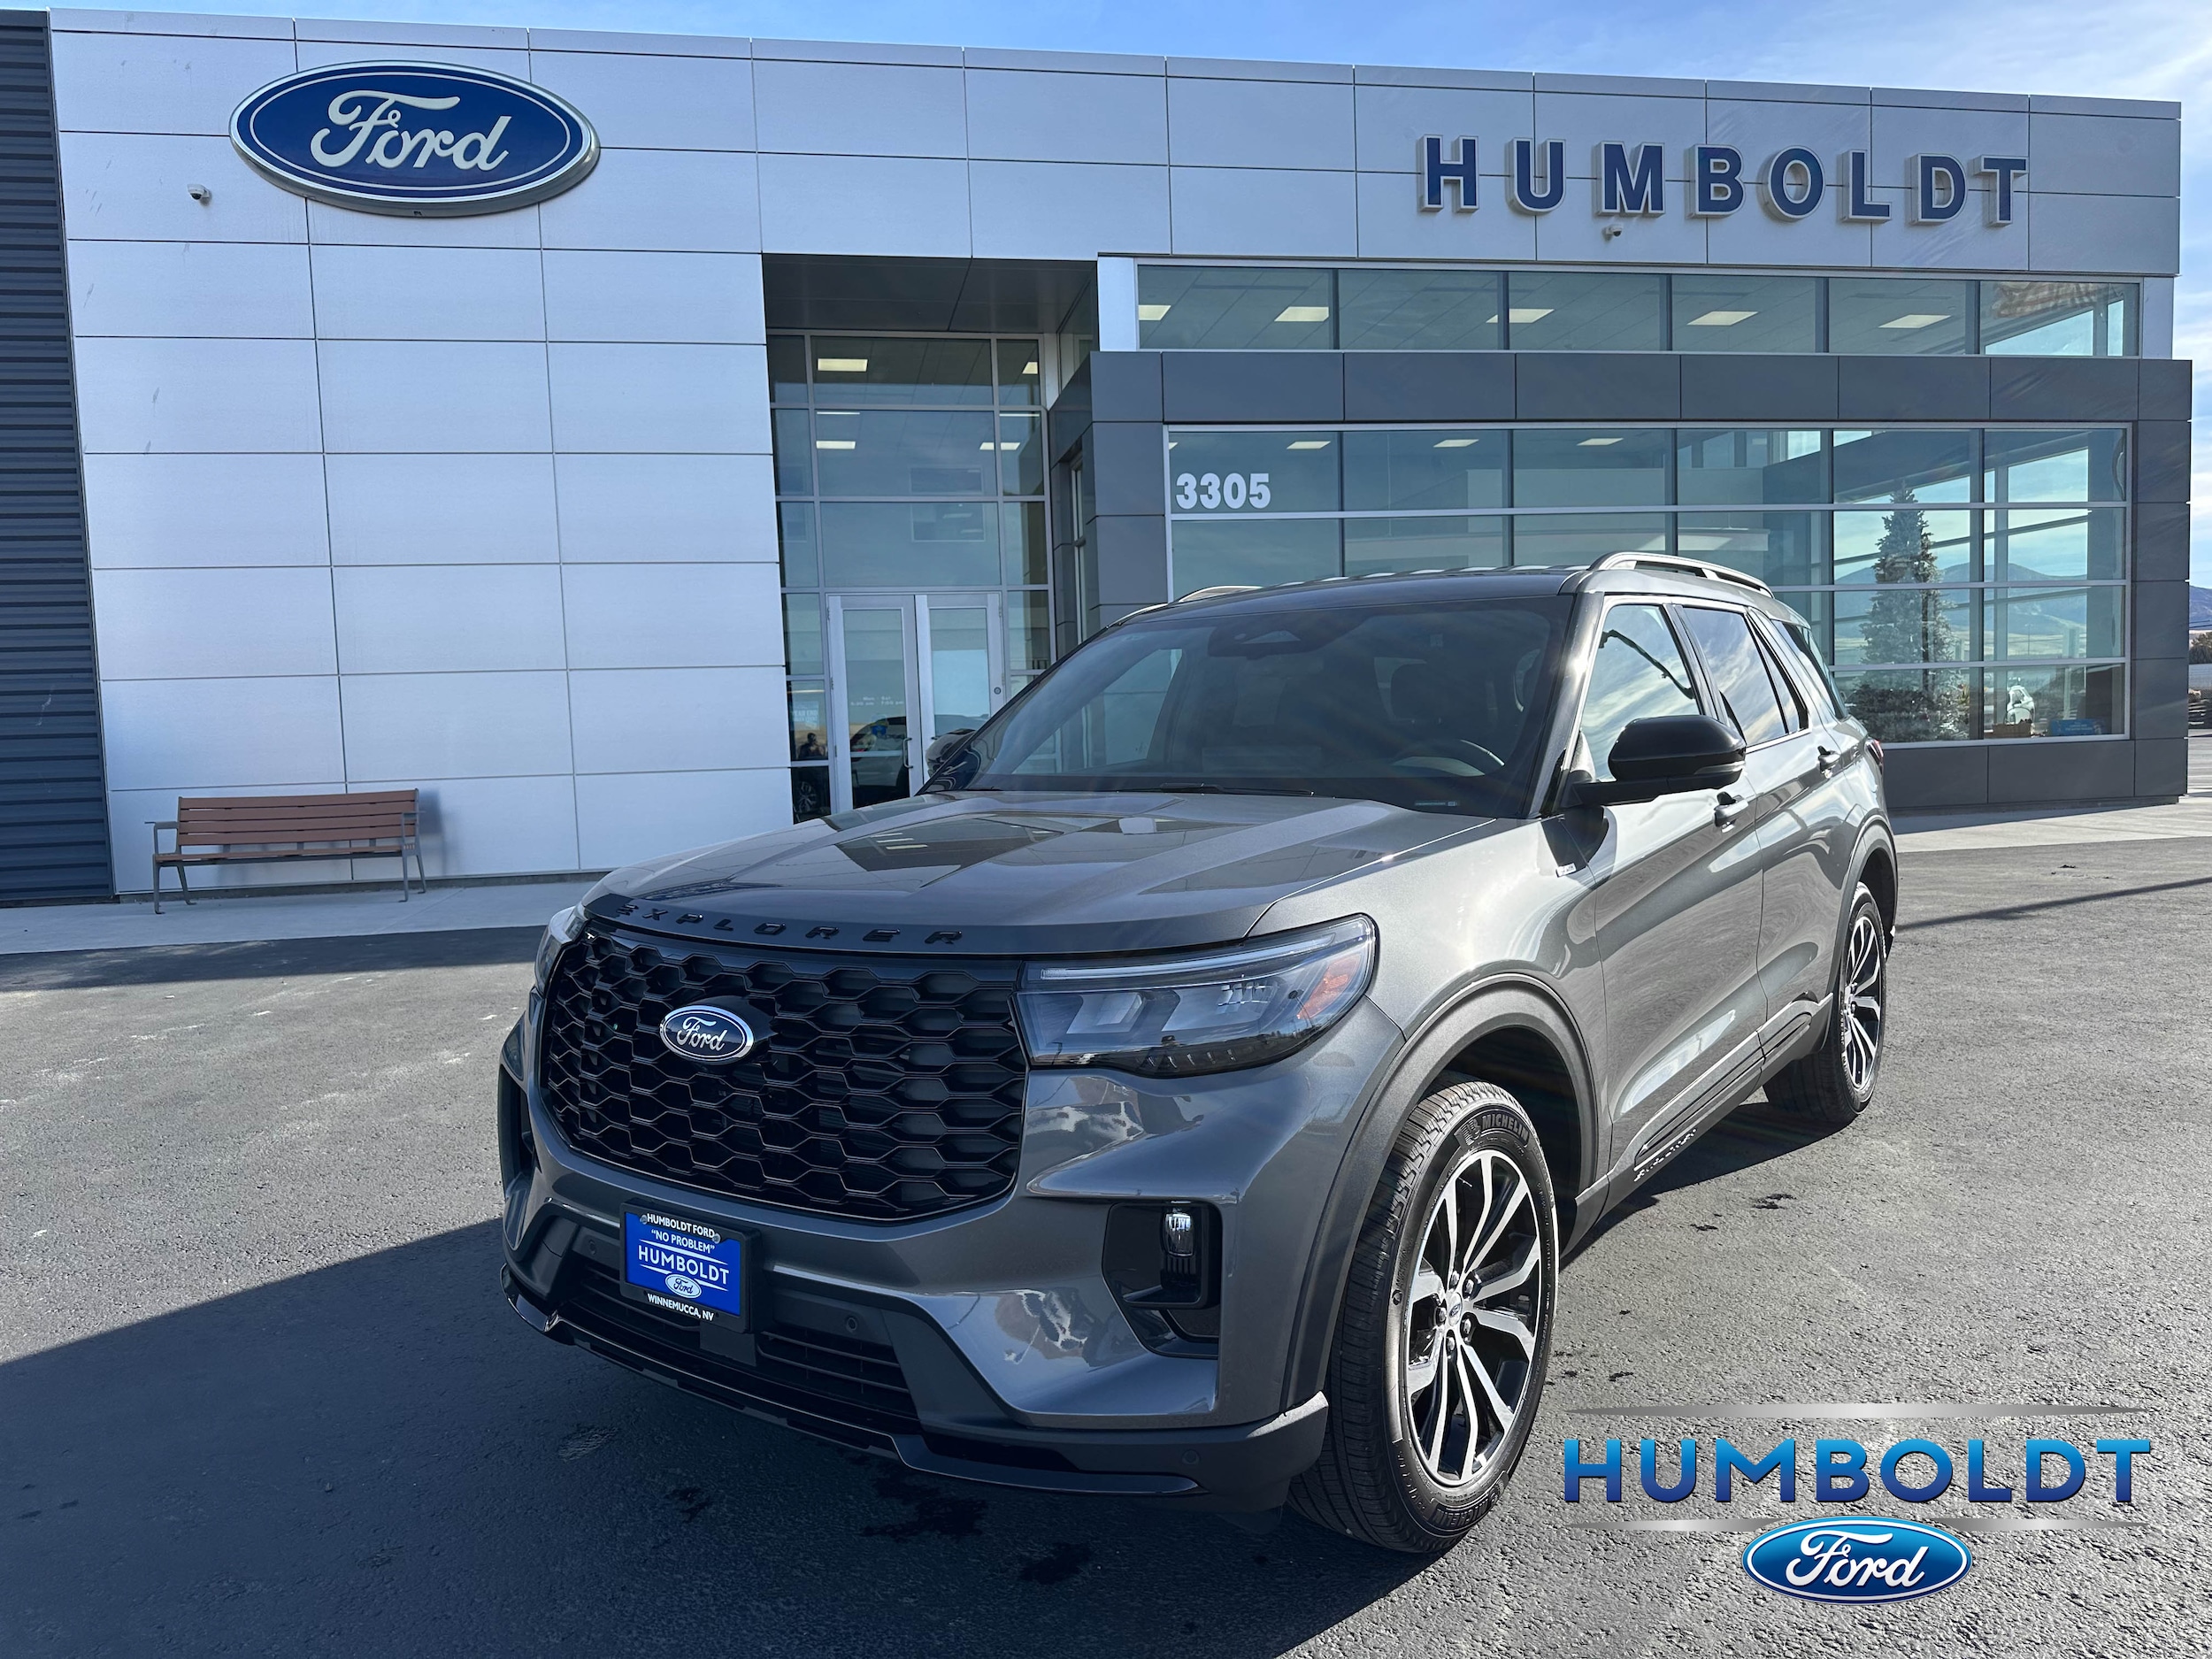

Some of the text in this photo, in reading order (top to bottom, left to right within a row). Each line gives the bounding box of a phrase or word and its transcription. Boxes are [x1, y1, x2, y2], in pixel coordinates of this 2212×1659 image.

[310, 89, 511, 172] Ford
[1420, 134, 2029, 227] HUMBOLDT
[1176, 472, 1271, 509] 3305
[616, 904, 963, 945] EXPLORER
[676, 1016, 726, 1051] Ford
[1482, 1113, 1529, 1141] MICHELIN
[647, 1213, 715, 1239] HUMBOLDT FORD
[638, 1245, 729, 1285] HUMBOLDT
[673, 1278, 694, 1294] Ford
[648, 1294, 714, 1321] WINNEMUCCA, NV
